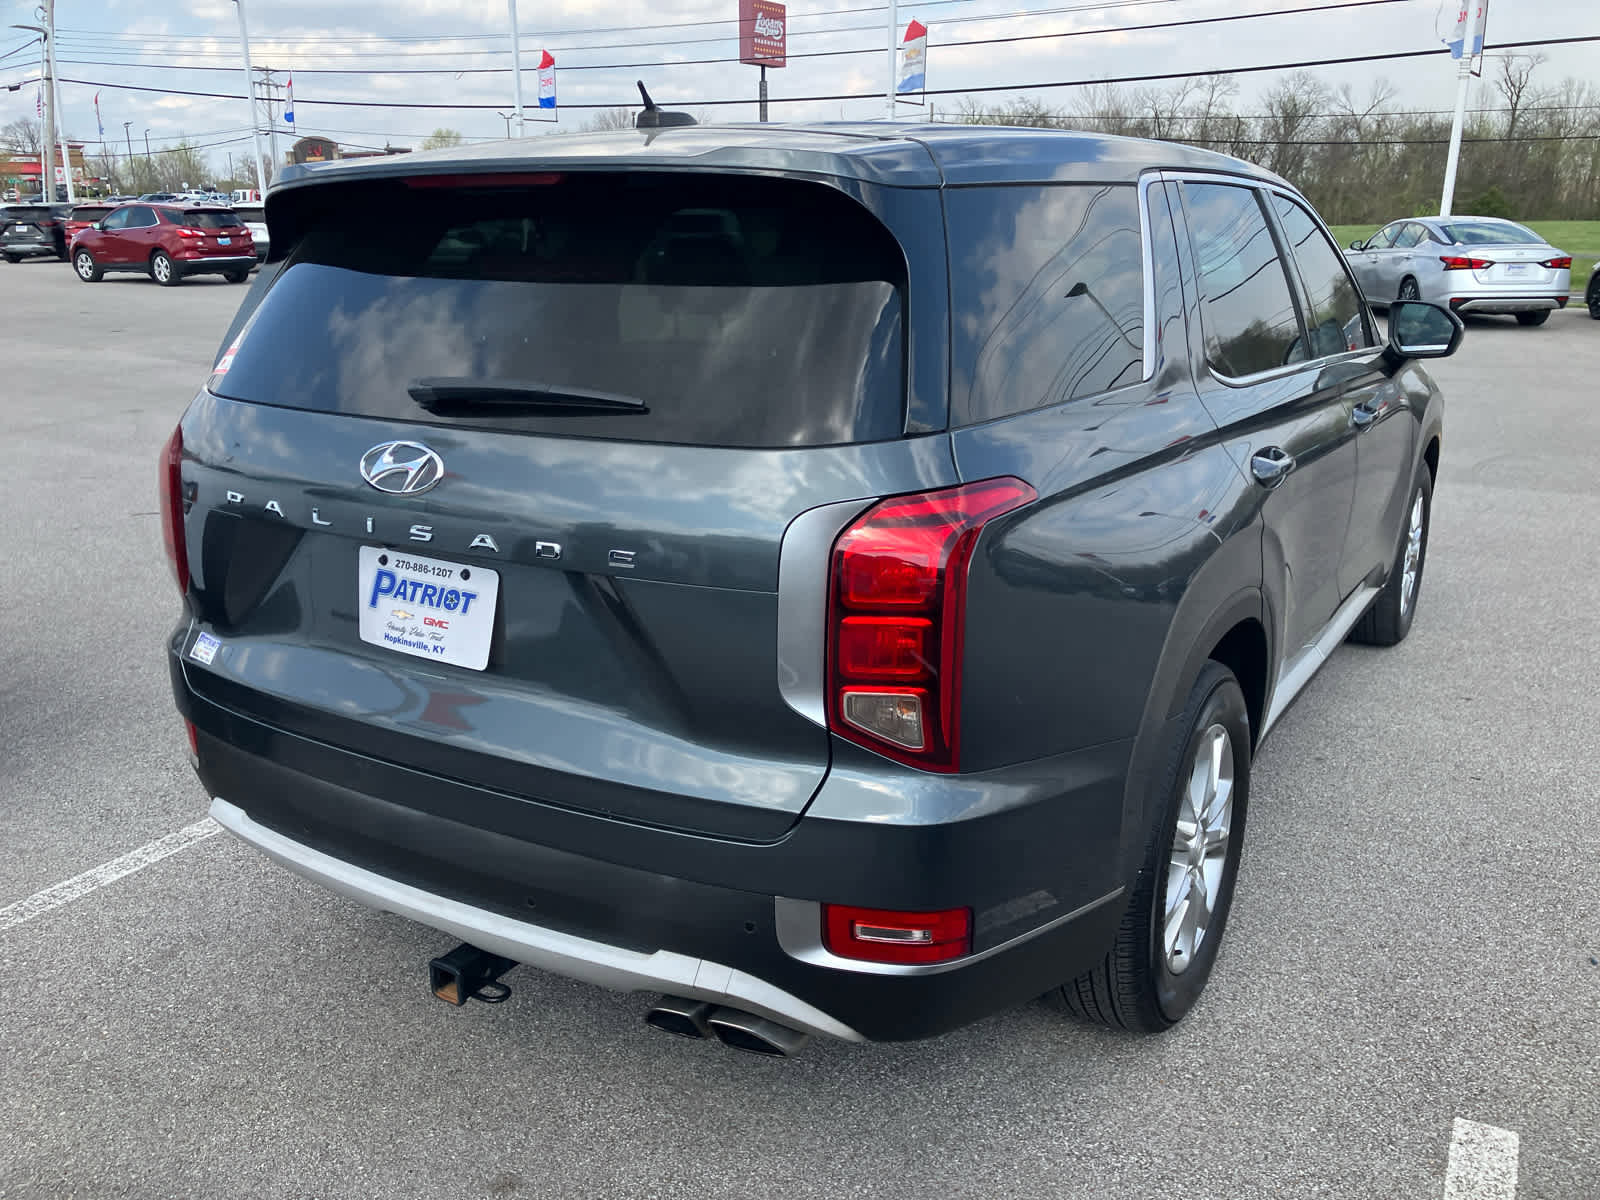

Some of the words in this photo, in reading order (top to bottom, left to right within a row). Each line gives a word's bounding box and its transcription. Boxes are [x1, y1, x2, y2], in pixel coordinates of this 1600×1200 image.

[226, 490, 637, 568] PALISADE
[395, 559, 453, 578] 270-886-1207
[369, 568, 477, 613] PATRIOT
[424, 616, 449, 629] GMC
[384, 632, 431, 653] Hopkinsville,
[432, 644, 446, 655] KY
